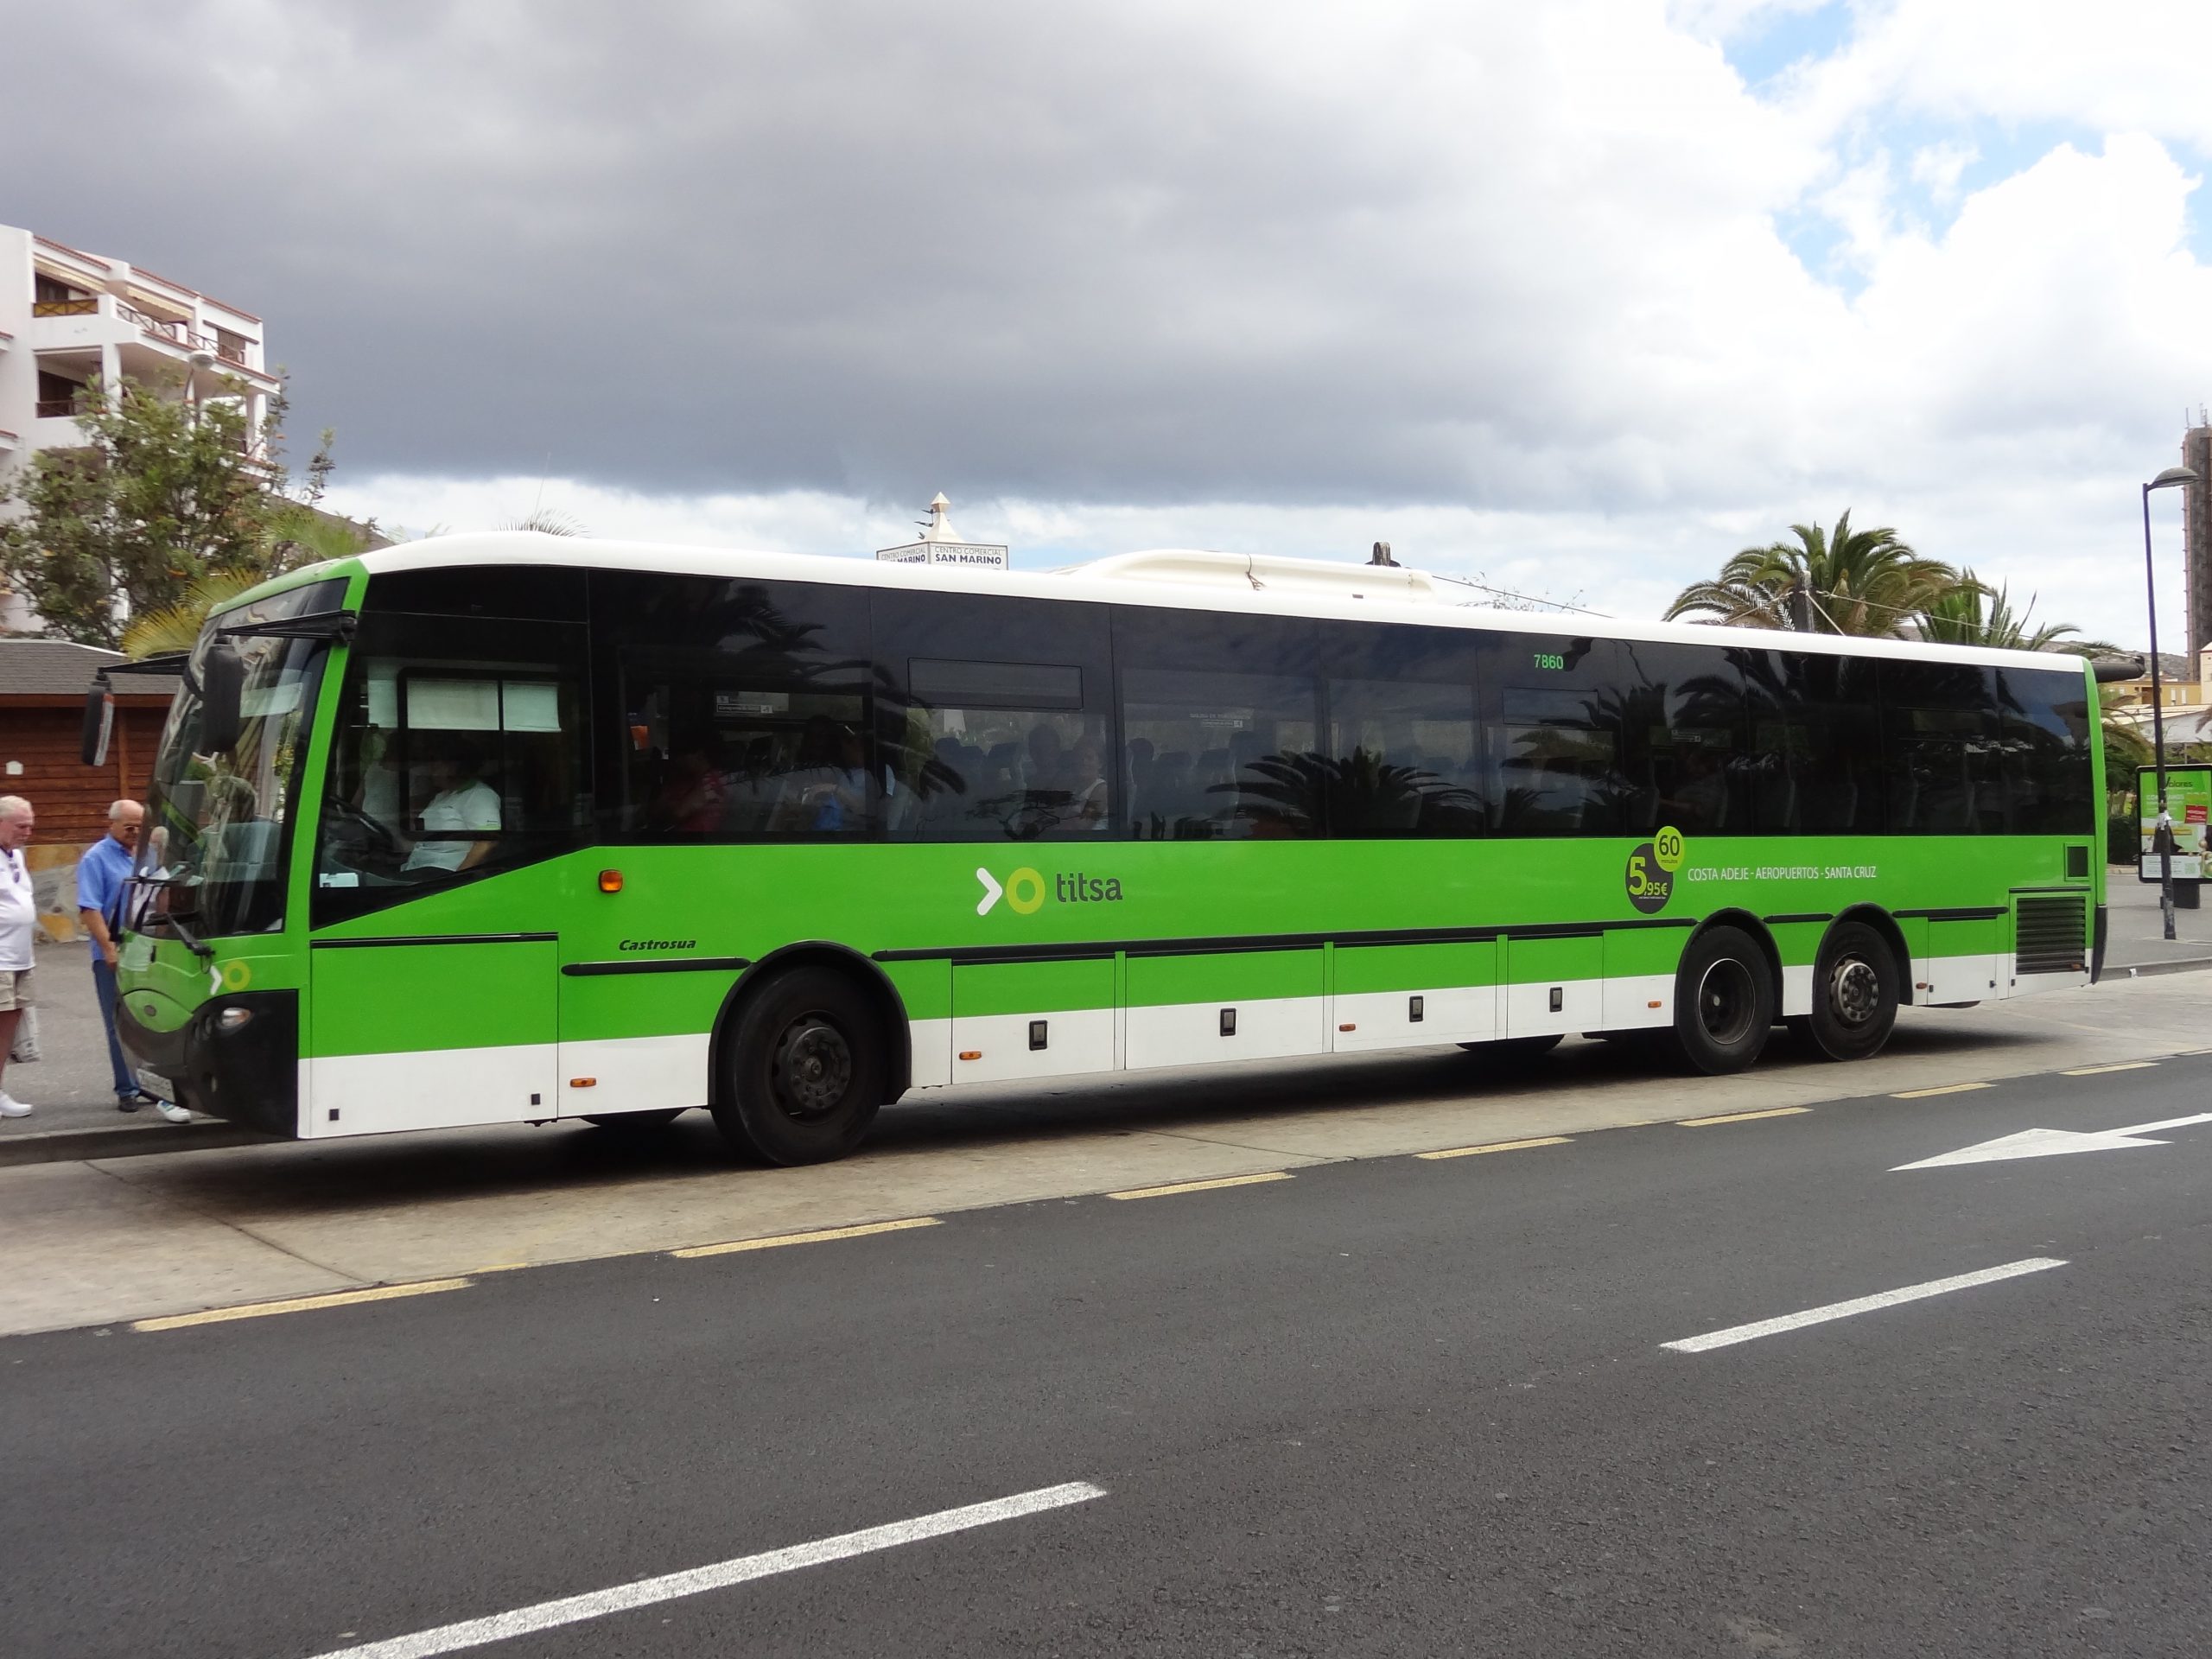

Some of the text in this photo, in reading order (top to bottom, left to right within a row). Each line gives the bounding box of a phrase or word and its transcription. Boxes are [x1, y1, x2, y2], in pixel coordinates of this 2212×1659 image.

[881, 547, 926, 561] CENTRO COMERCIAL
[935, 553, 1002, 564] SAN MARINO
[1534, 654, 1564, 670] 7860
[1658, 834, 1681, 856] 60
[1688, 866, 1877, 881] COSTA ADEJE AEROPUERTOS SANTA CRUZ
[1056, 872, 1123, 903] titsa
[619, 939, 697, 950] Castrosua
